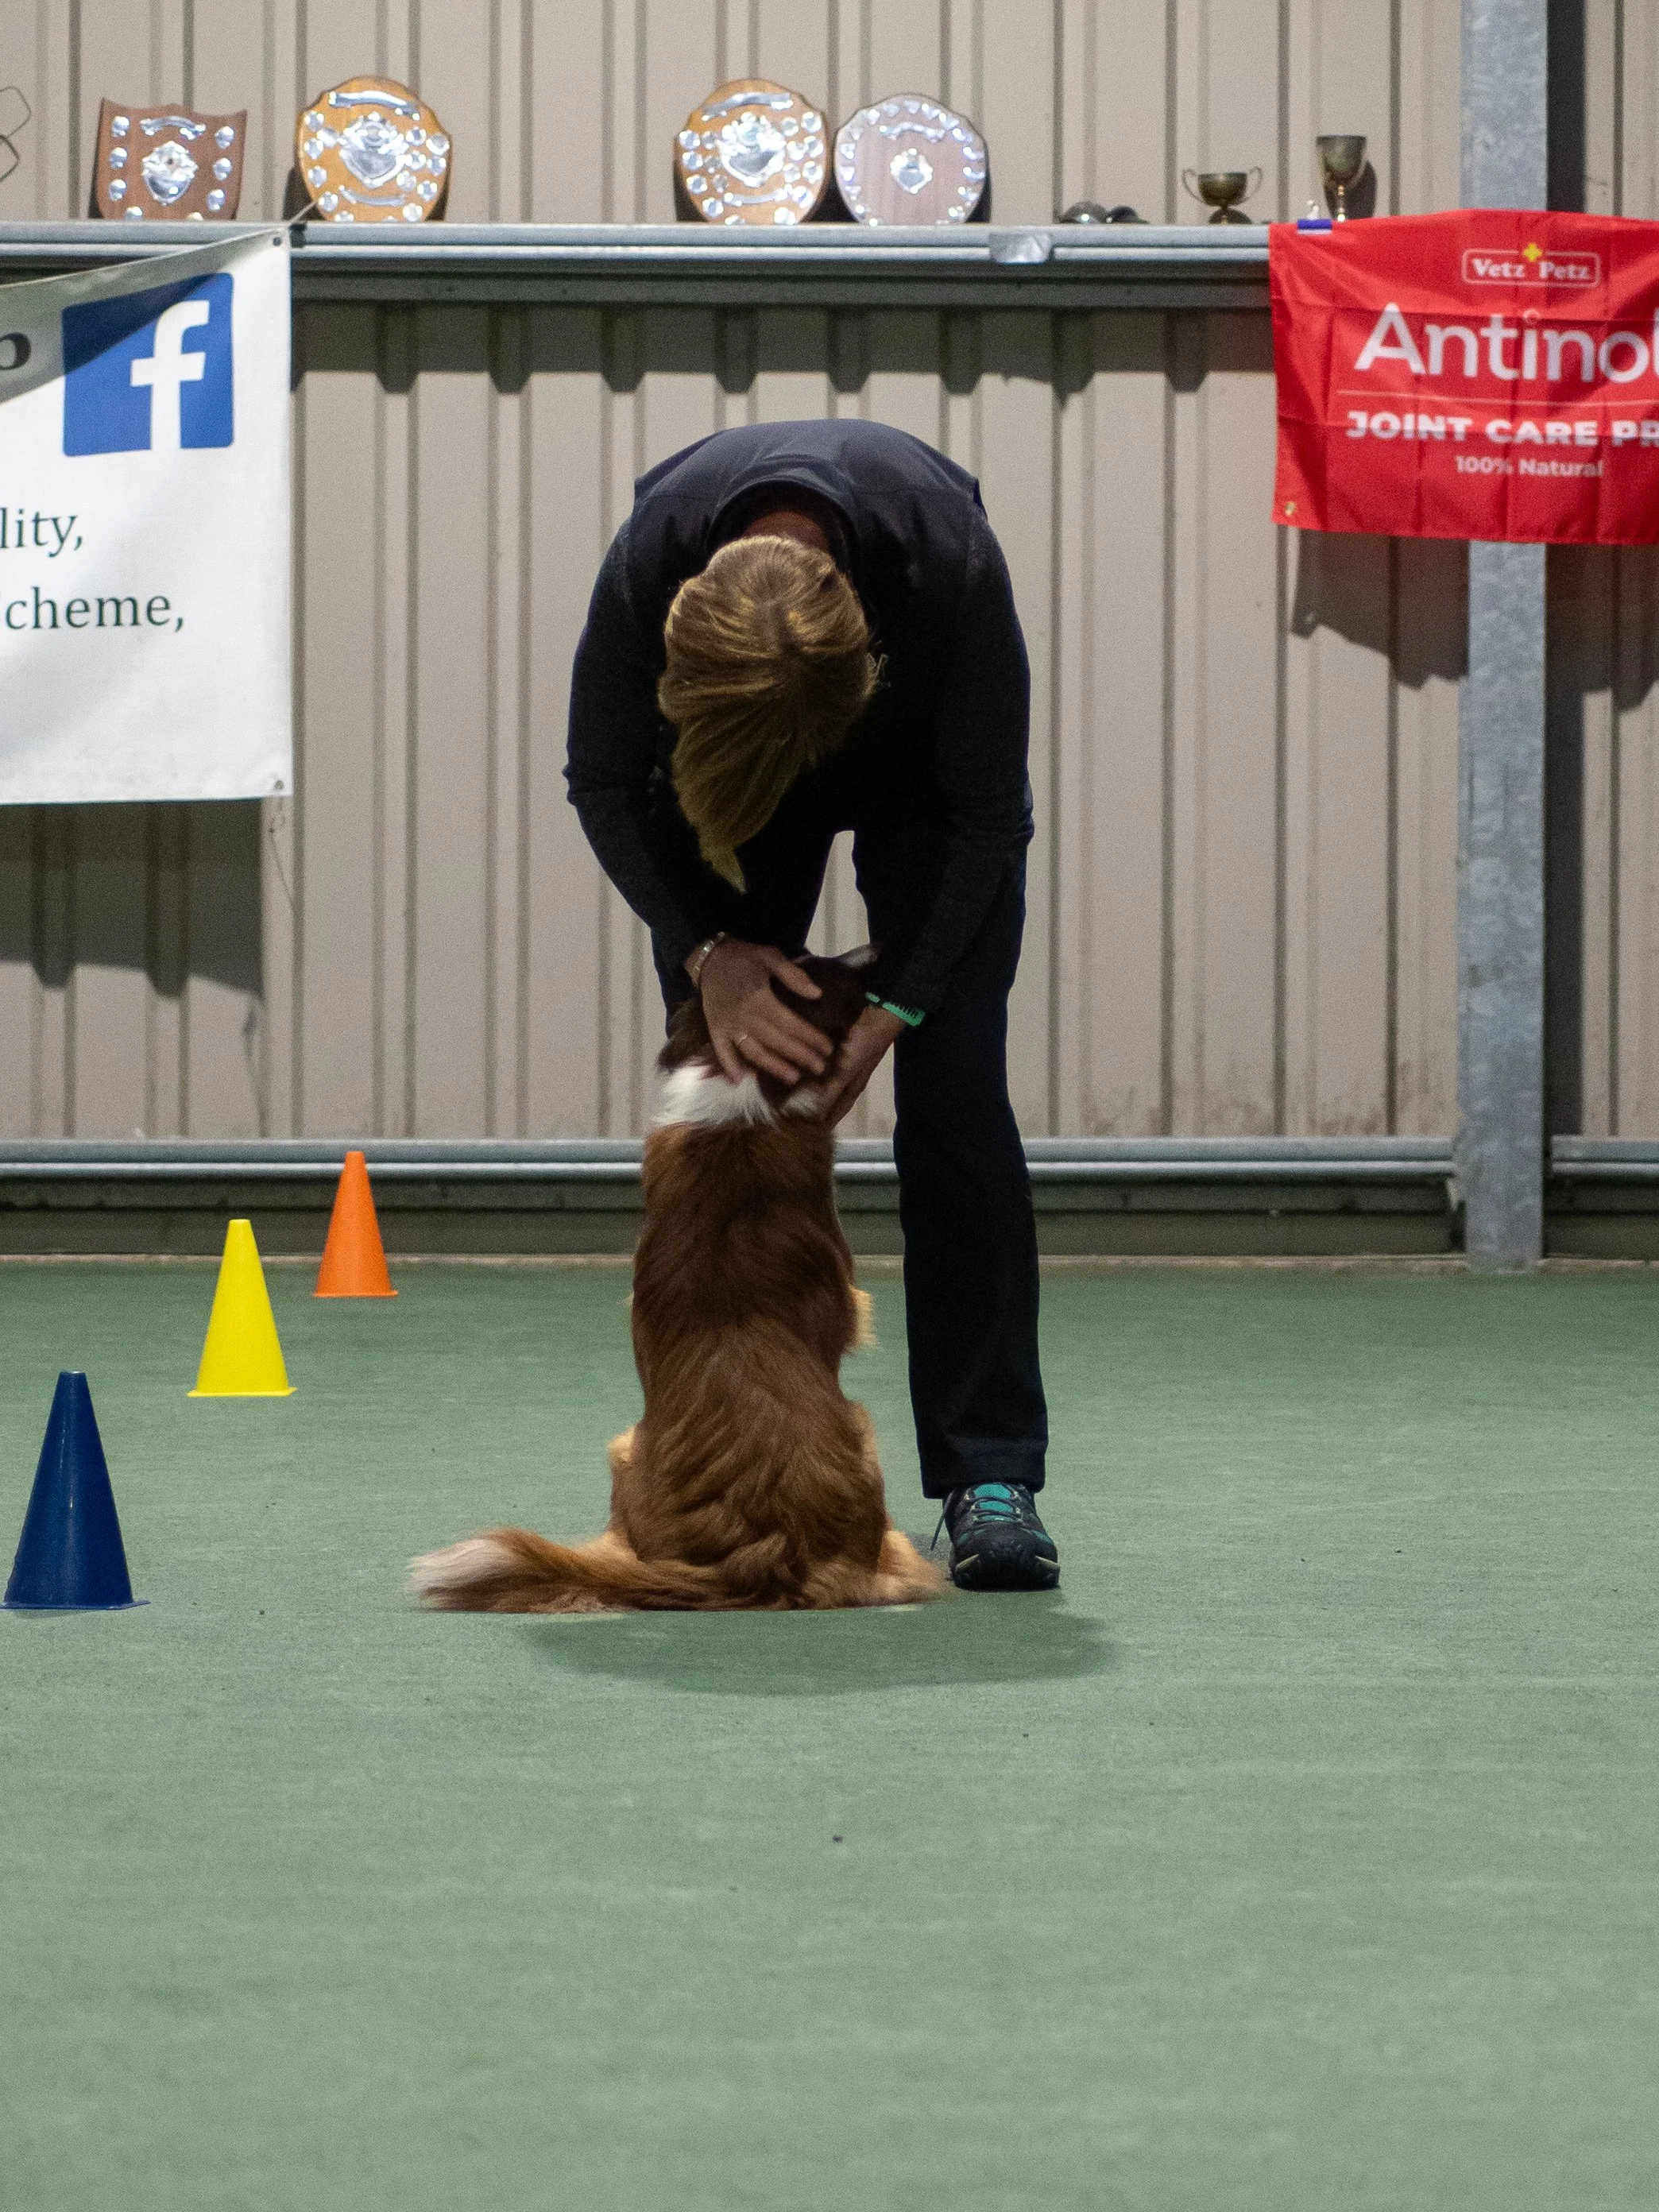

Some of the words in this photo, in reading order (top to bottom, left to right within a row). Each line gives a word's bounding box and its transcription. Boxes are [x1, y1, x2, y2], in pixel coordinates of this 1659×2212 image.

[1472, 258, 1525, 277] Vetz
[1539, 261, 1589, 279] Petz
[1347, 411, 1472, 441] JOINT
[1485, 419, 1598, 446] CARE
[1455, 455, 1514, 474] 100%
[1518, 459, 1603, 477] Natural
